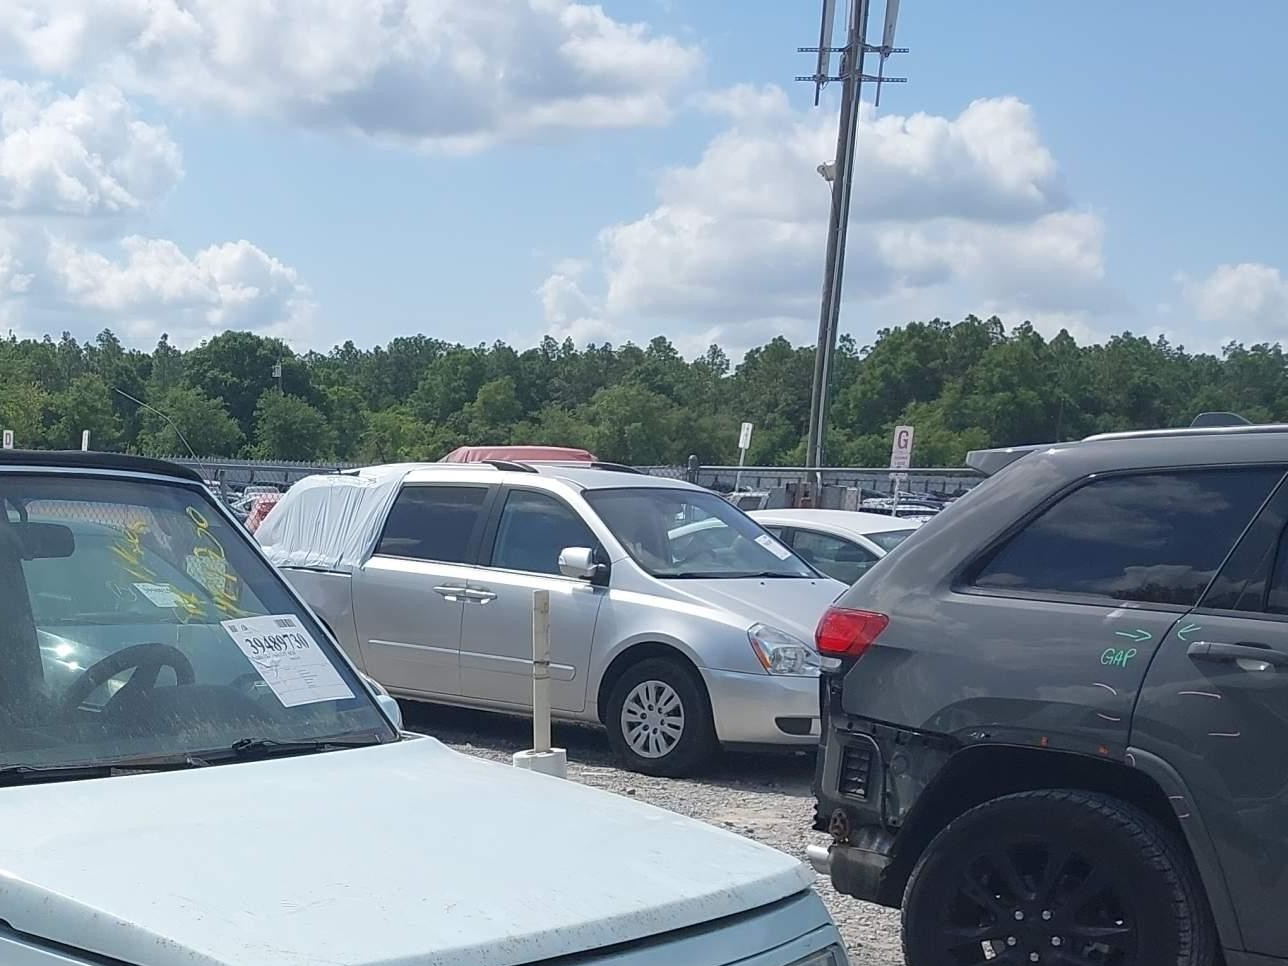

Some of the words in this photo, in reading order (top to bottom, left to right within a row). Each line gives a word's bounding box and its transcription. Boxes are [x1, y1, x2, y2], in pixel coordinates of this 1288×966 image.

[898, 430, 909, 449] G
[245, 632, 310, 655] 39489730
[1100, 647, 1137, 668] GAP
